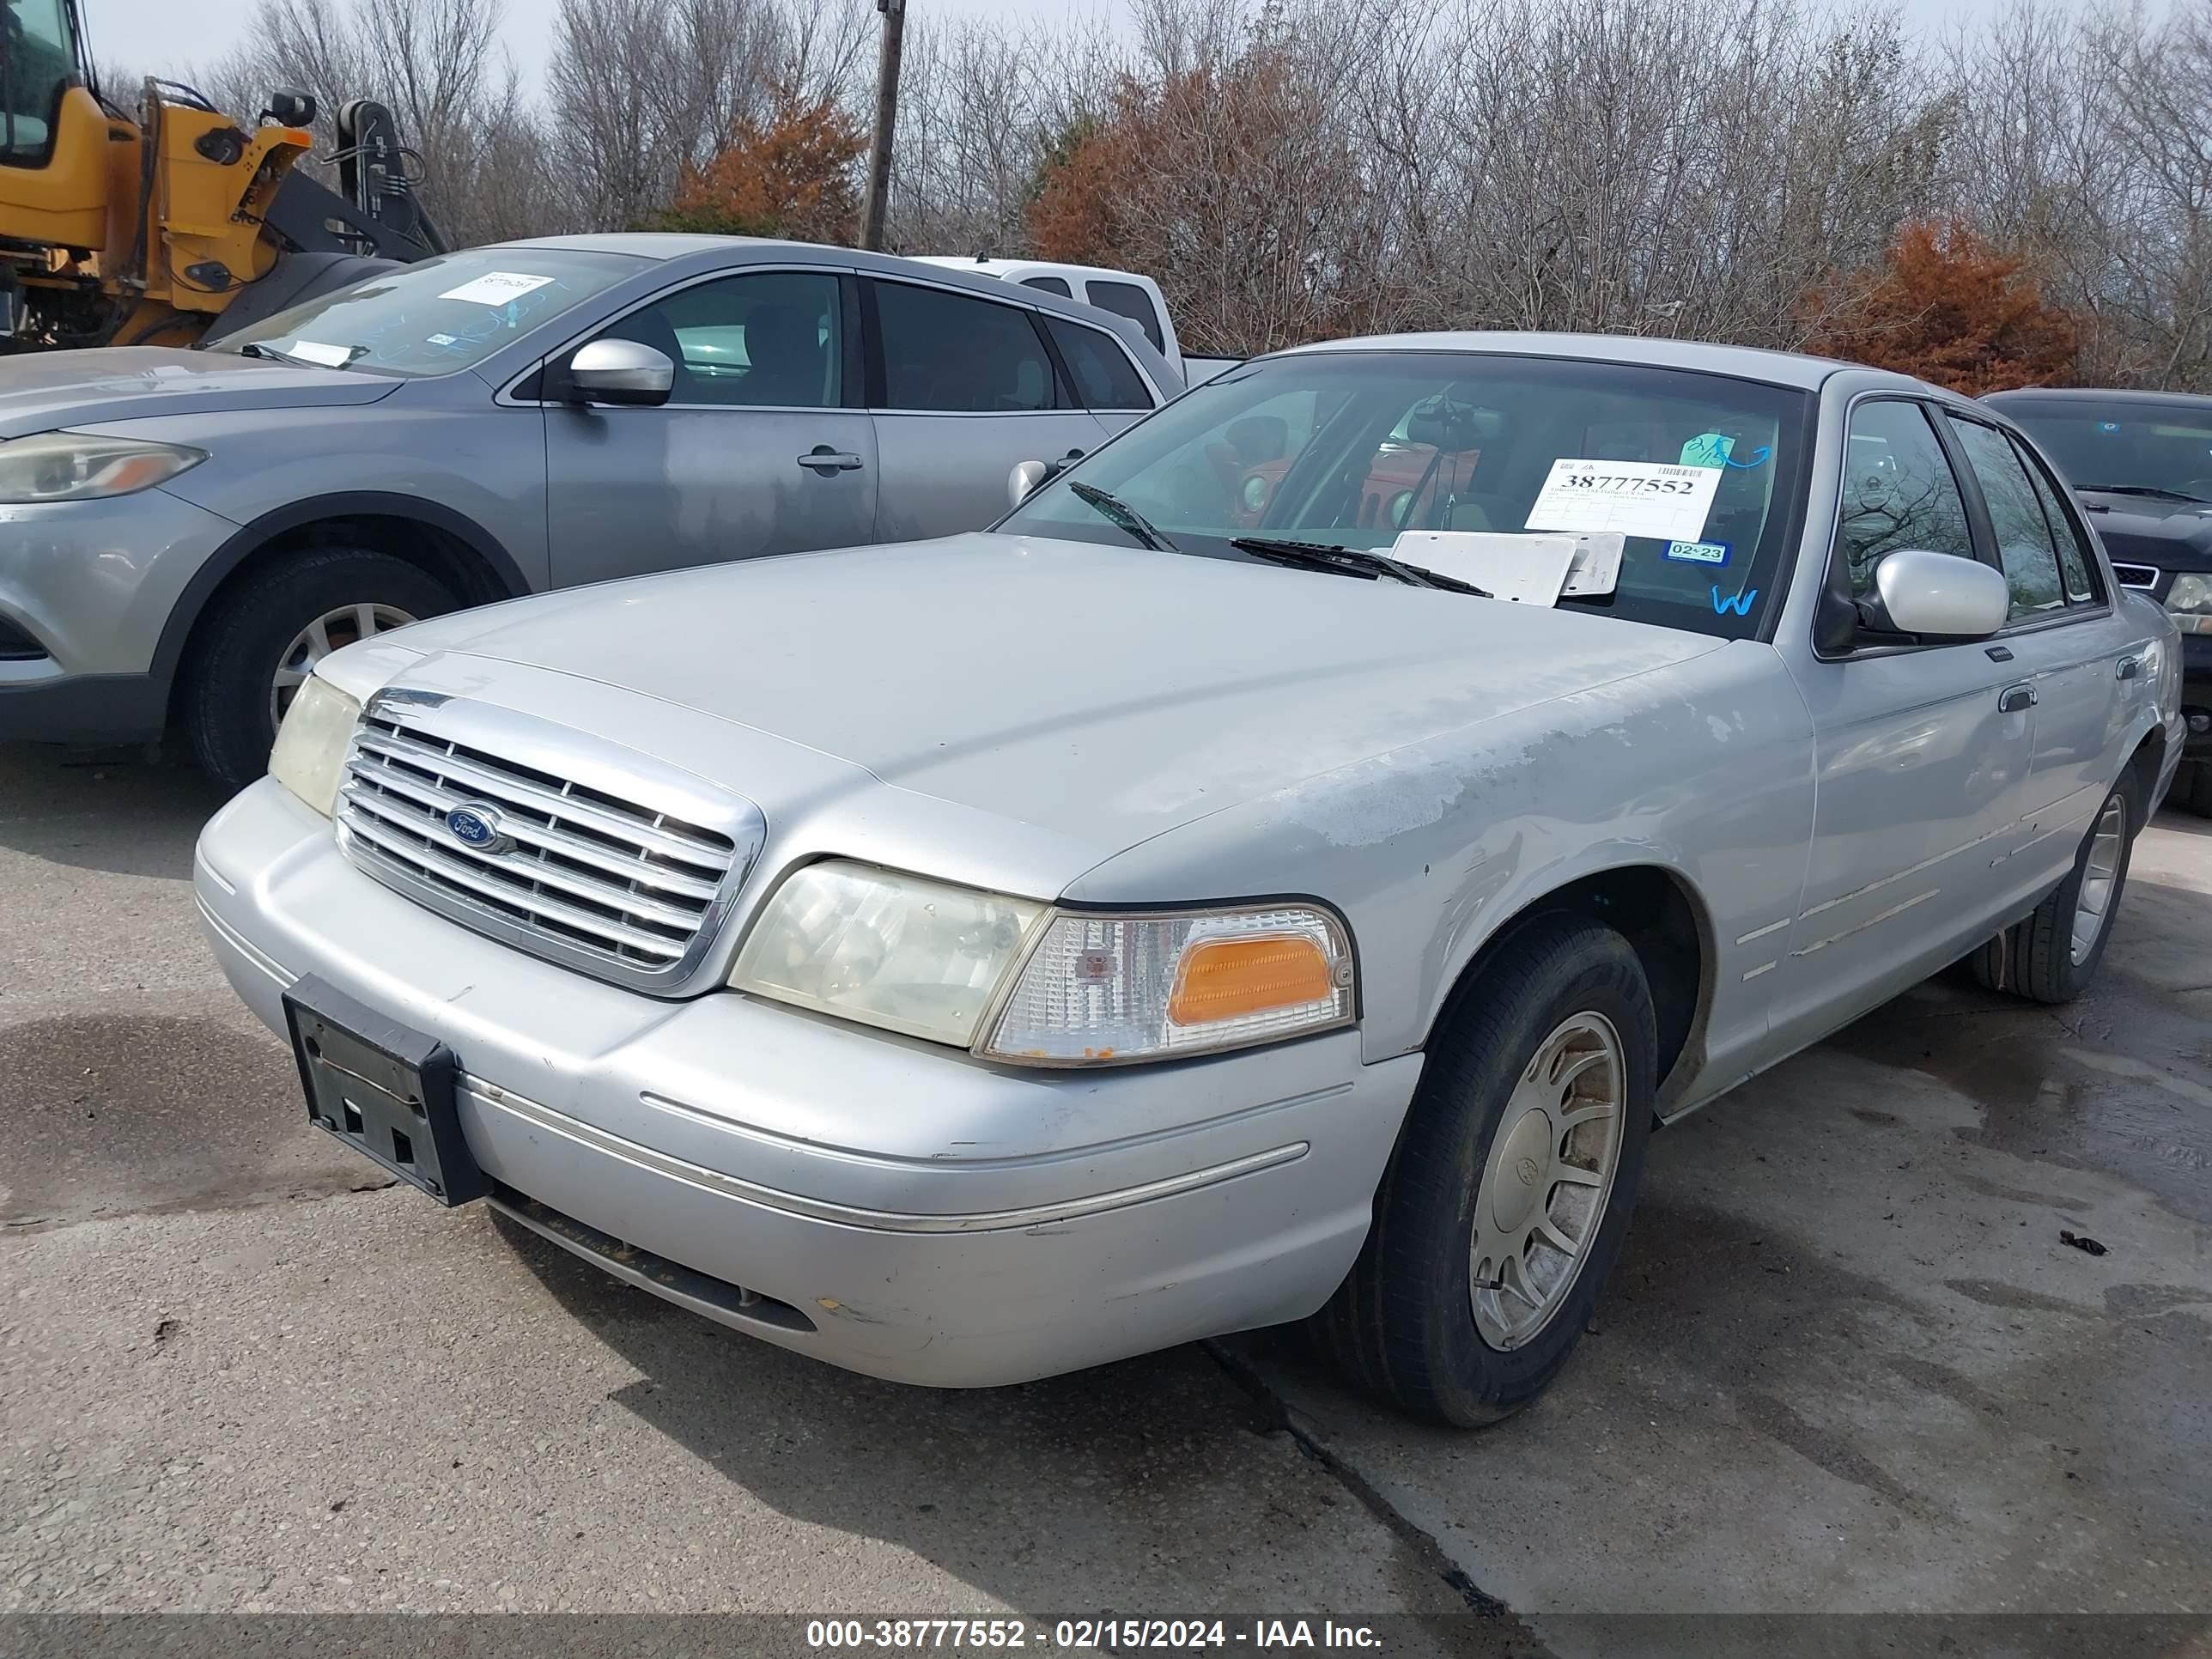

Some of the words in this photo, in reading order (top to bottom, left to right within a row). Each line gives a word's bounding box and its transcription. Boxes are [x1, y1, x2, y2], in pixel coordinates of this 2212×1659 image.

[1561, 475, 1693, 495] 38777552
[1672, 544, 1693, 555] 02
[1700, 548, 1722, 559] 23
[1711, 585, 1759, 616] W
[454, 814, 482, 839] Ford
